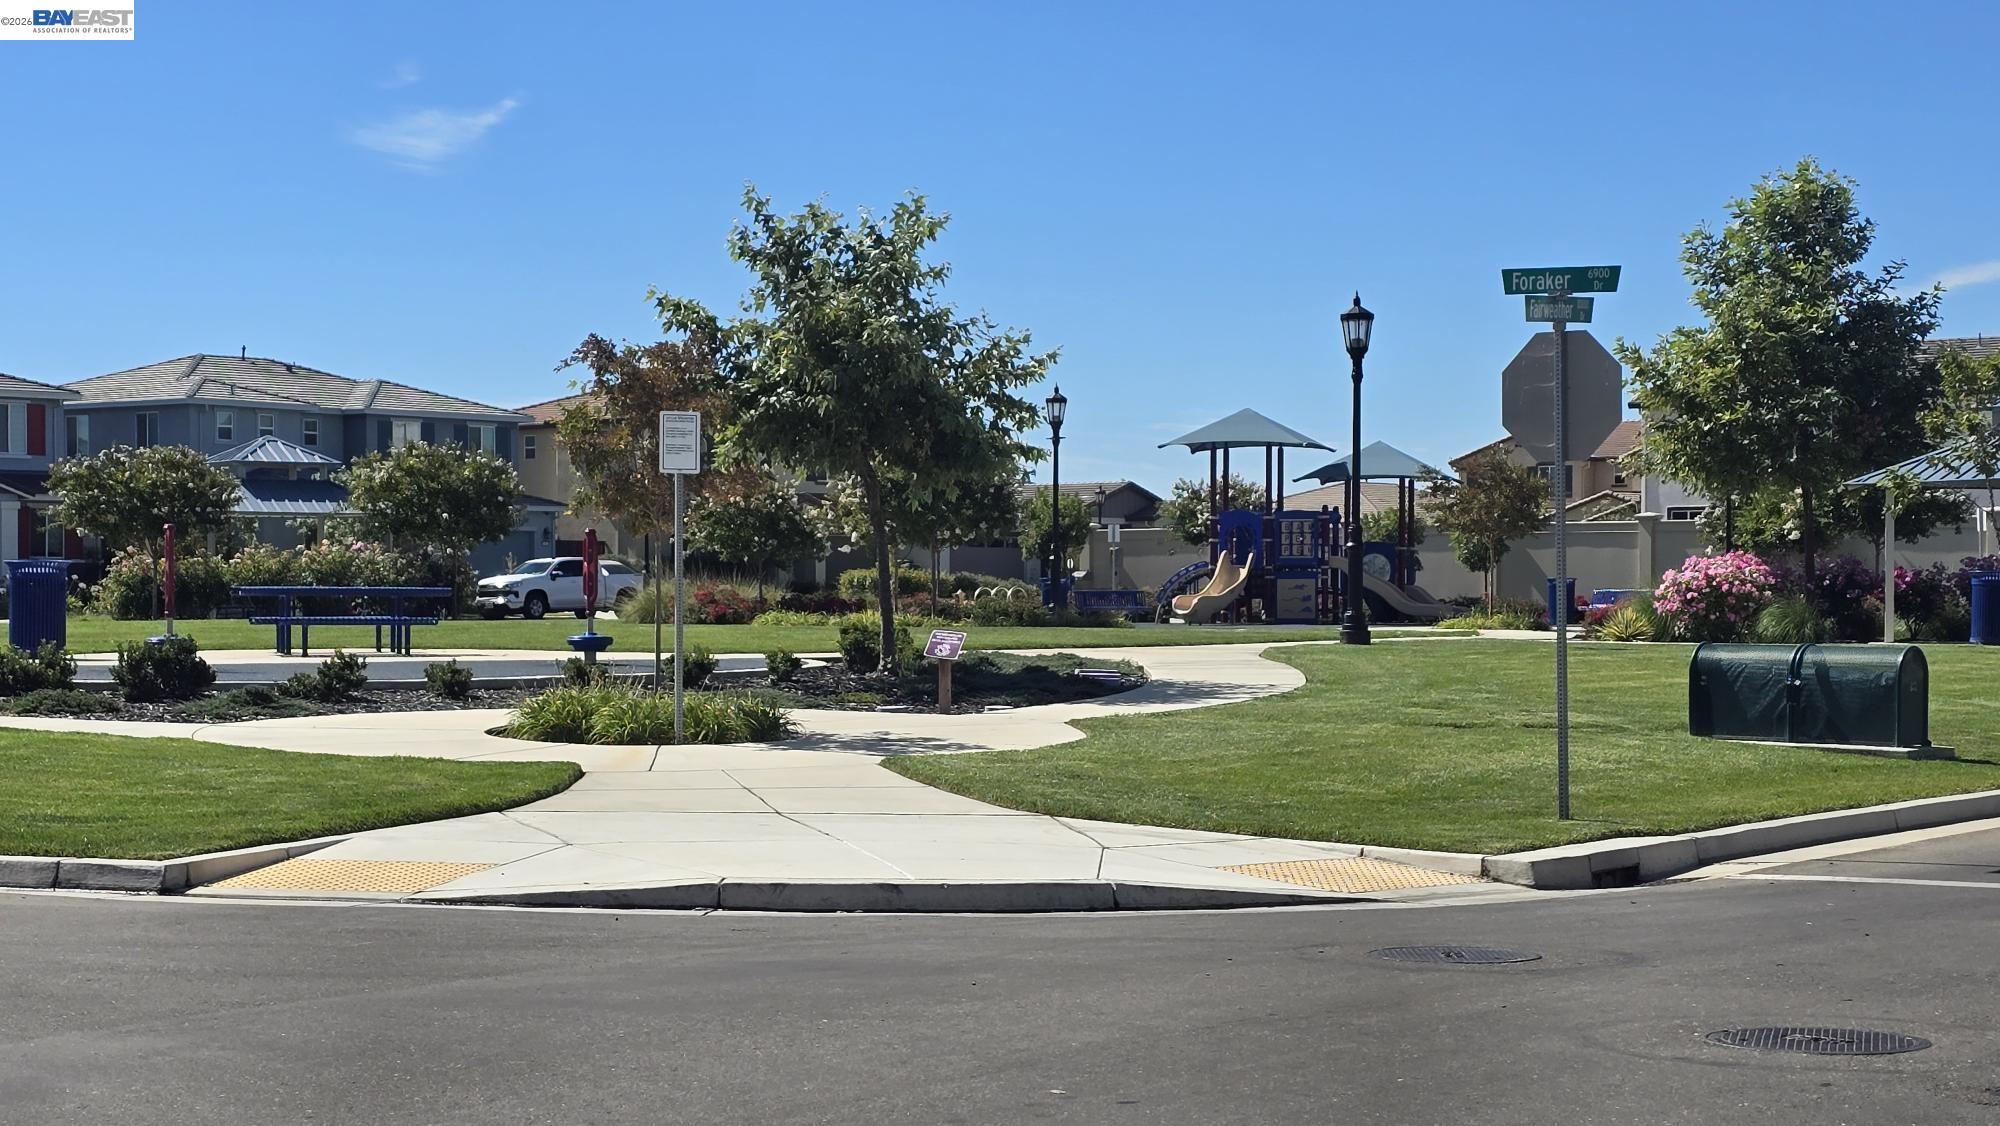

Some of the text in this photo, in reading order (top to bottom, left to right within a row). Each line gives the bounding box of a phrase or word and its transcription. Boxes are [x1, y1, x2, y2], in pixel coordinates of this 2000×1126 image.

[1512, 272, 1604, 291] Foraker Dr
[1588, 268, 1610, 279] 6900
[1529, 299, 1574, 319] Fairweather
